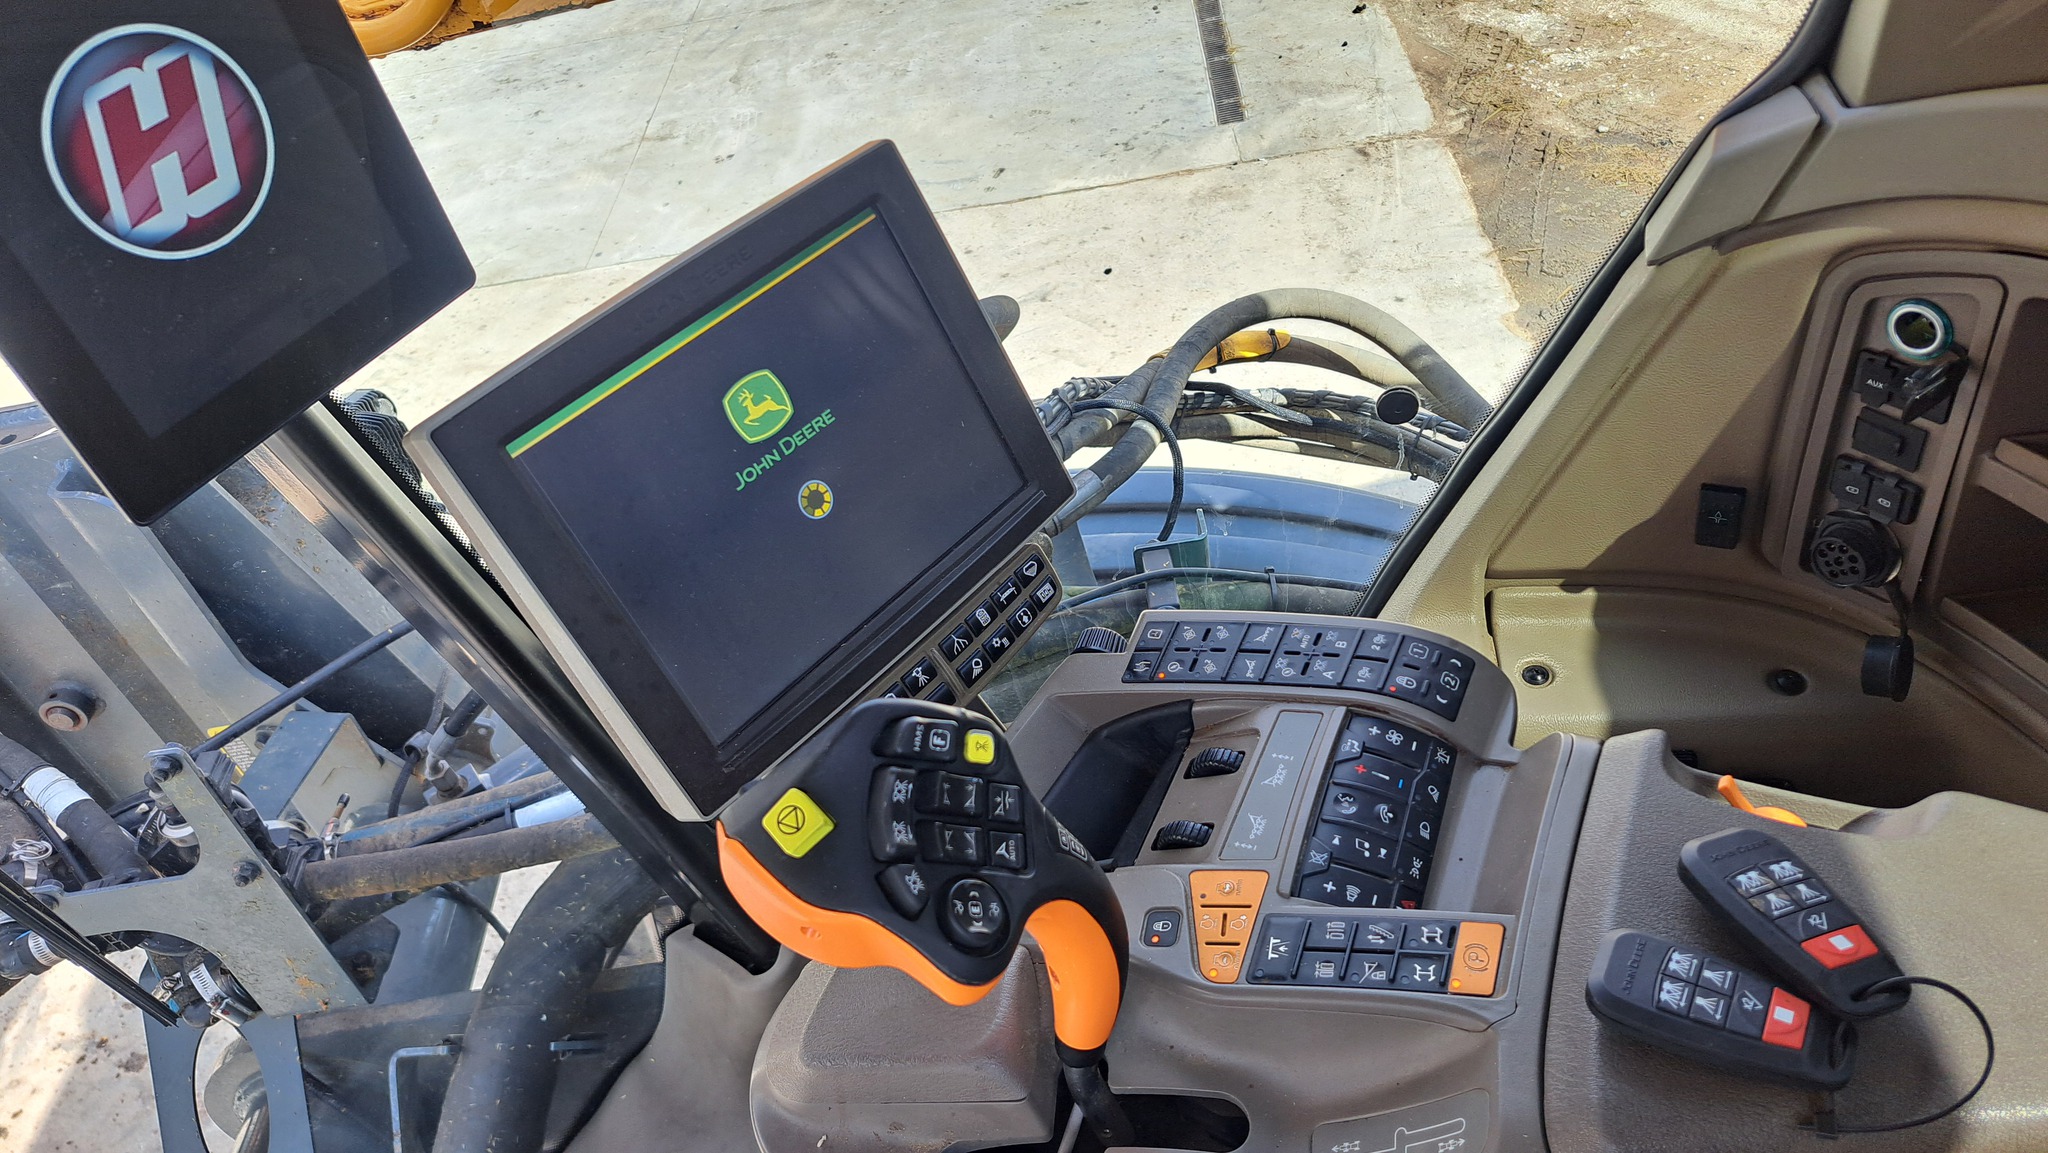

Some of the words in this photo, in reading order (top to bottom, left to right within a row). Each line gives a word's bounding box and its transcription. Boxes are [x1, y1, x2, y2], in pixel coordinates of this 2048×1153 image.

[1865, 378, 1884, 390] AUX
[735, 448, 782, 492] JOHN
[777, 408, 836, 456] DEERE
[1300, 634, 1311, 649] AUTO
[1412, 646, 1424, 654] 1
[1322, 670, 1336, 680] A
[1444, 676, 1456, 686] 2
[913, 724, 925, 752] HMS
[933, 735, 946, 746] F
[1008, 839, 1017, 861] AUTO
[971, 904, 980, 913] E
